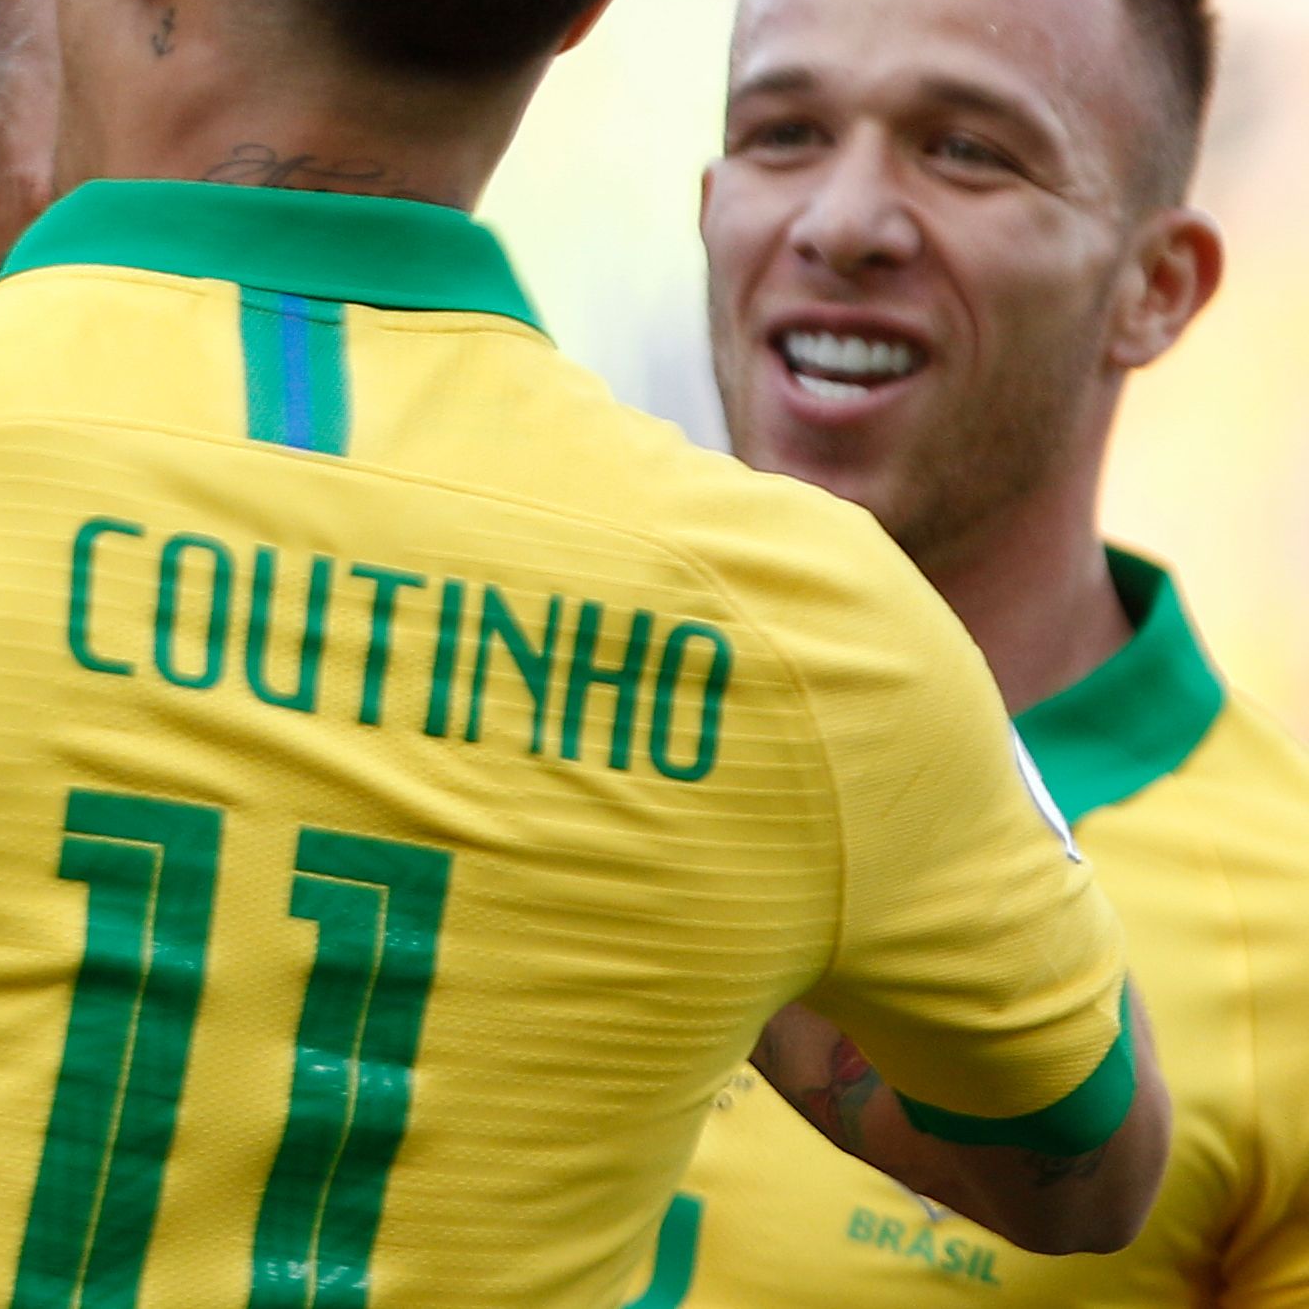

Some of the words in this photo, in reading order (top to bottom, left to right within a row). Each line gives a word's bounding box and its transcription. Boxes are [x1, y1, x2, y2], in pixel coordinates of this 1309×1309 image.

[67, 515, 736, 784] COUTINHO
[11, 787, 455, 1309] 11
[847, 1205, 1000, 1286] BRASIL
